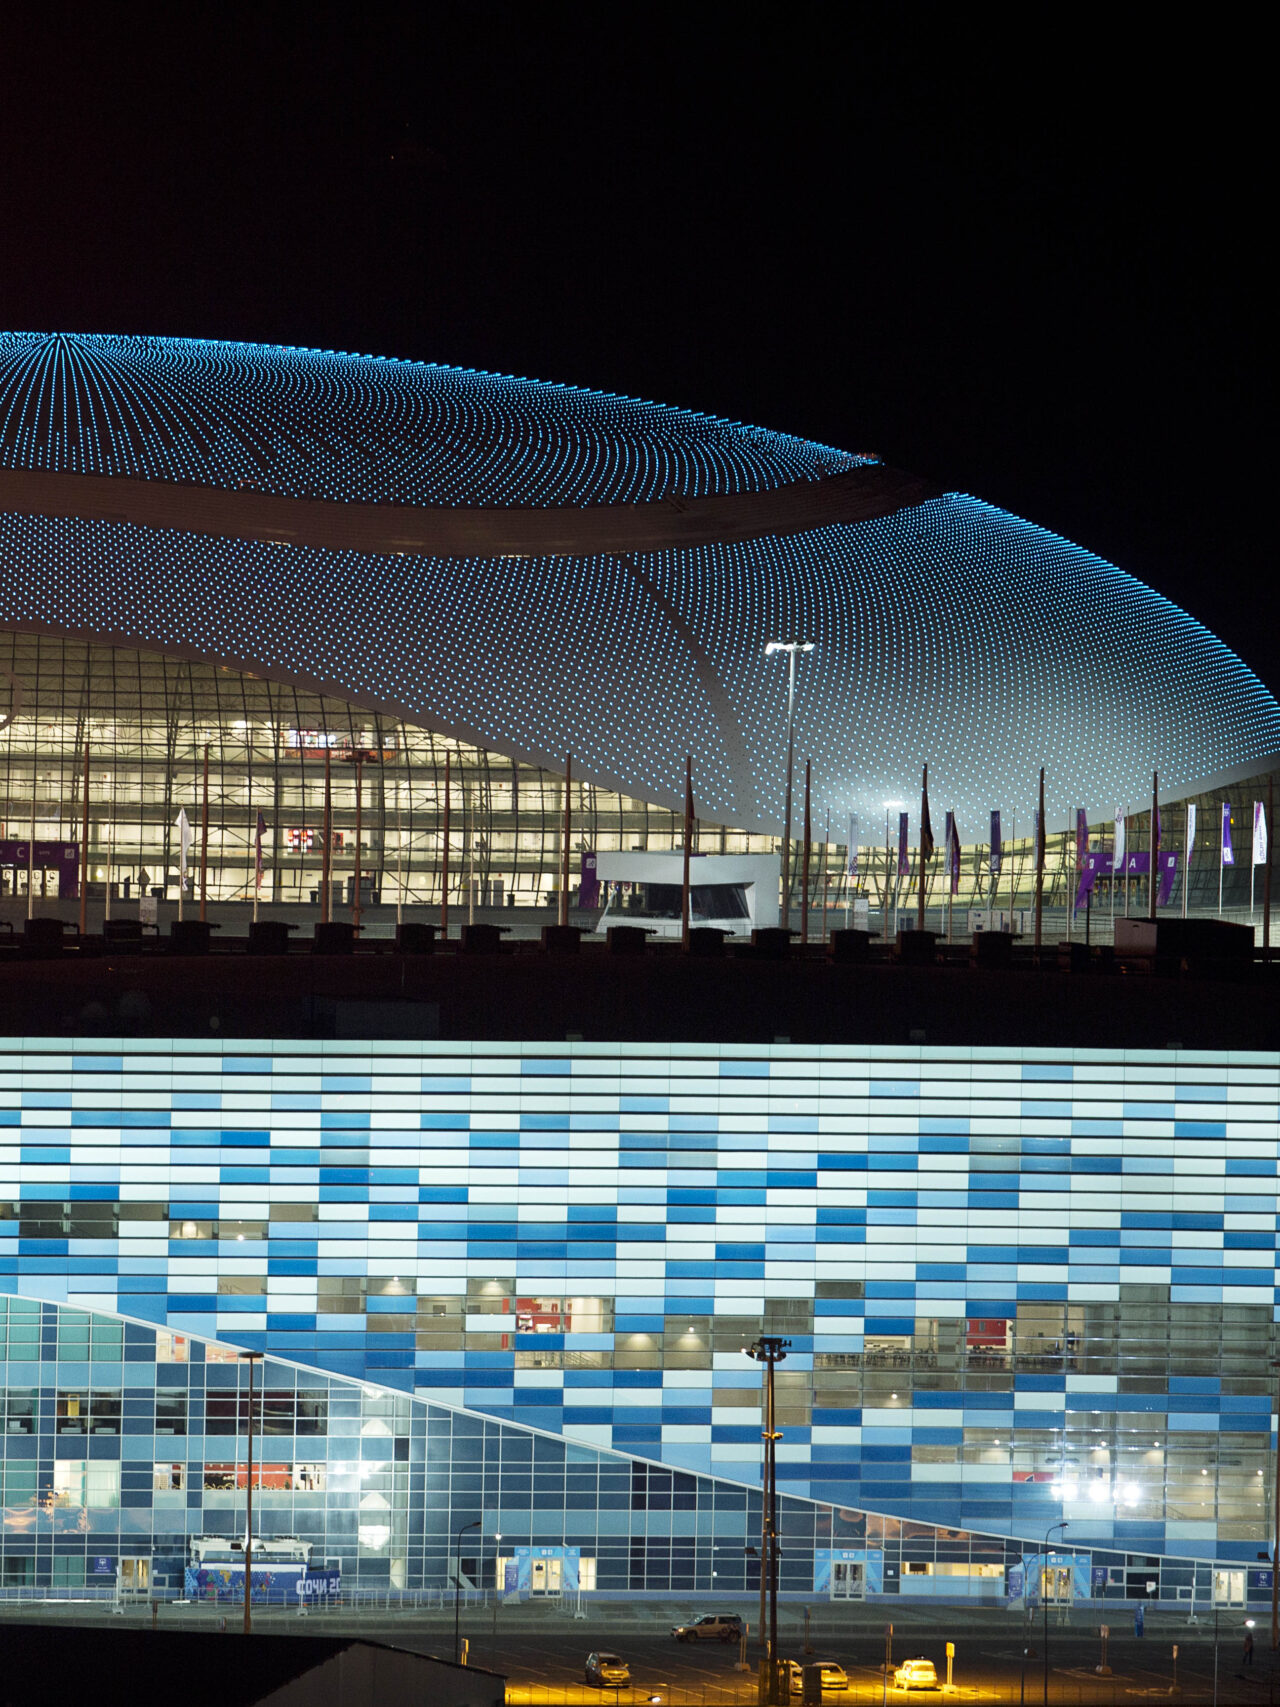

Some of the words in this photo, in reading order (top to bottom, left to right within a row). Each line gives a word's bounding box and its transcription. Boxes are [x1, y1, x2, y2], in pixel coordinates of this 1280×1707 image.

[16, 847, 25, 858] C
[1129, 857, 1136, 868] A
[296, 1578, 327, 1595] СОЧИ
